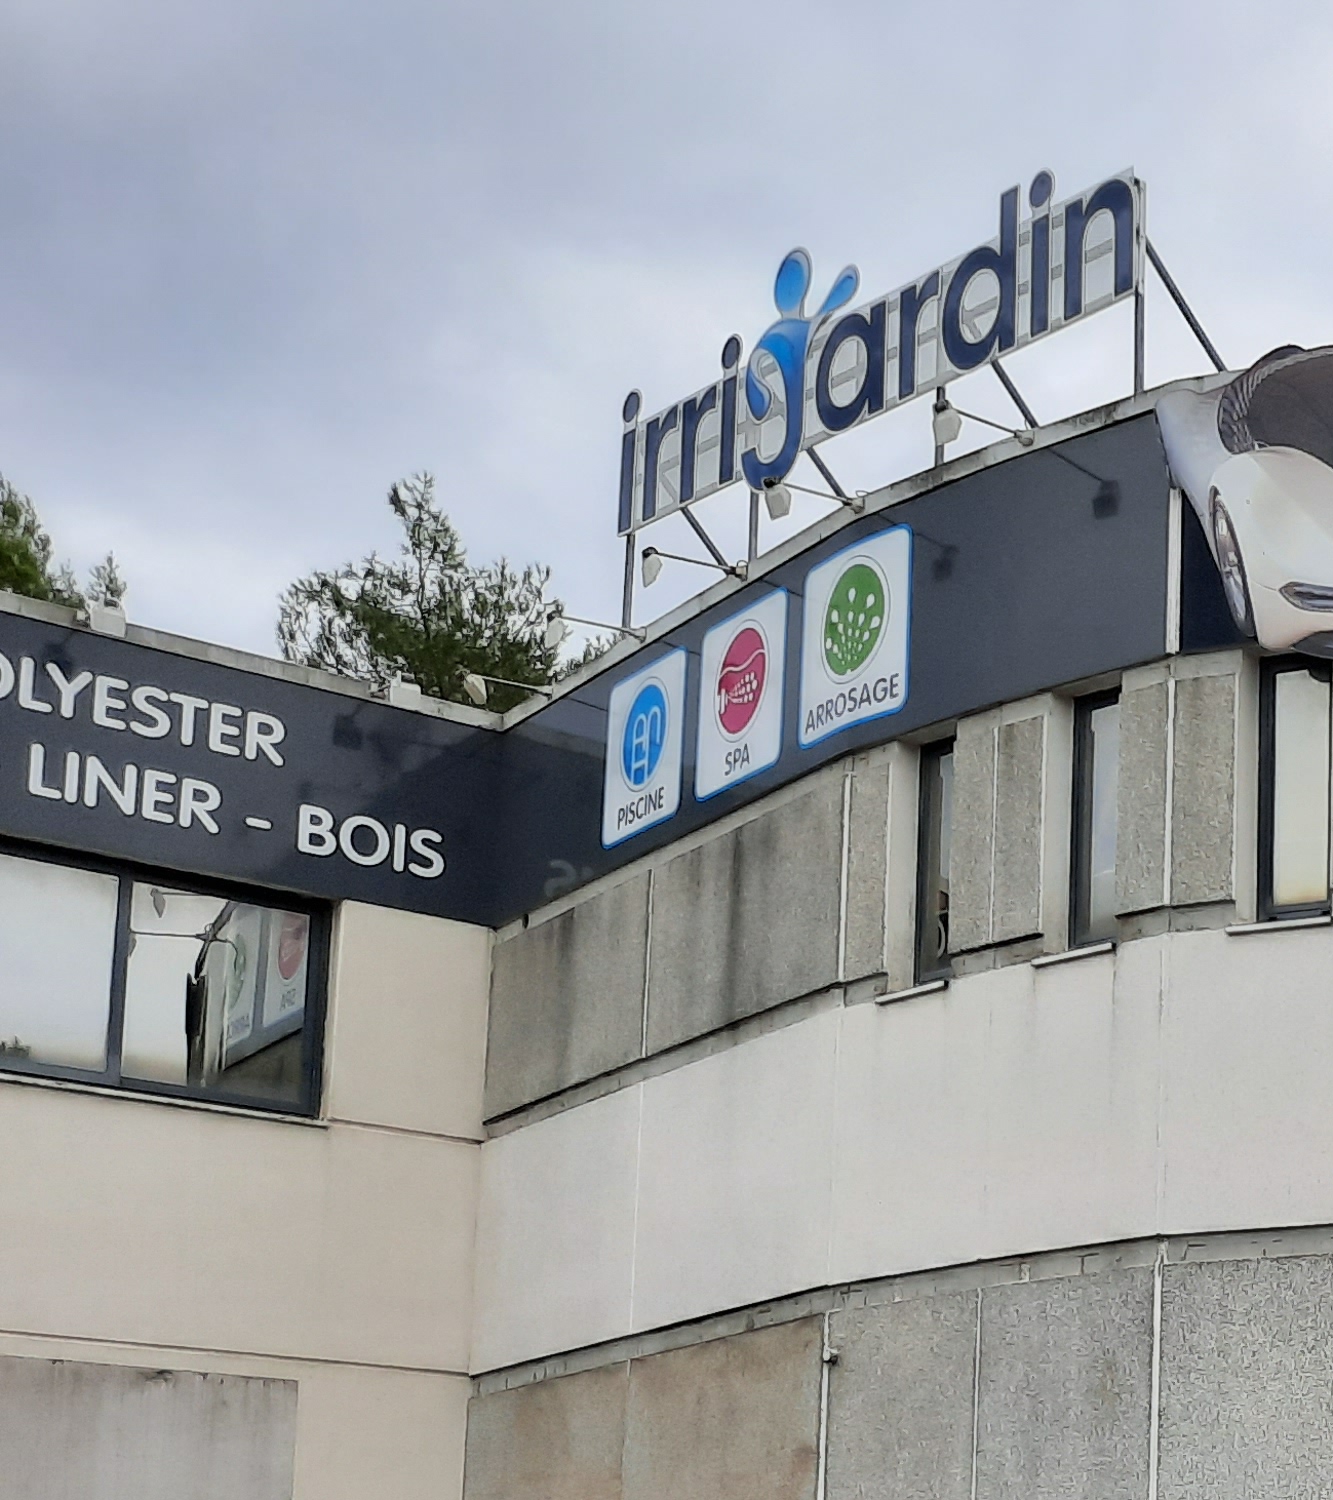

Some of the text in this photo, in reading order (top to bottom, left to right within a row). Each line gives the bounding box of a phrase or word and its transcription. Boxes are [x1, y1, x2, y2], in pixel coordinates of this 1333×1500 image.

[804, 673, 900, 736] ARROSAGE
[724, 742, 750, 775] SPA
[27, 742, 221, 834] LINER
[298, 803, 446, 878] BOIS
[616, 785, 665, 831] PISCINE
